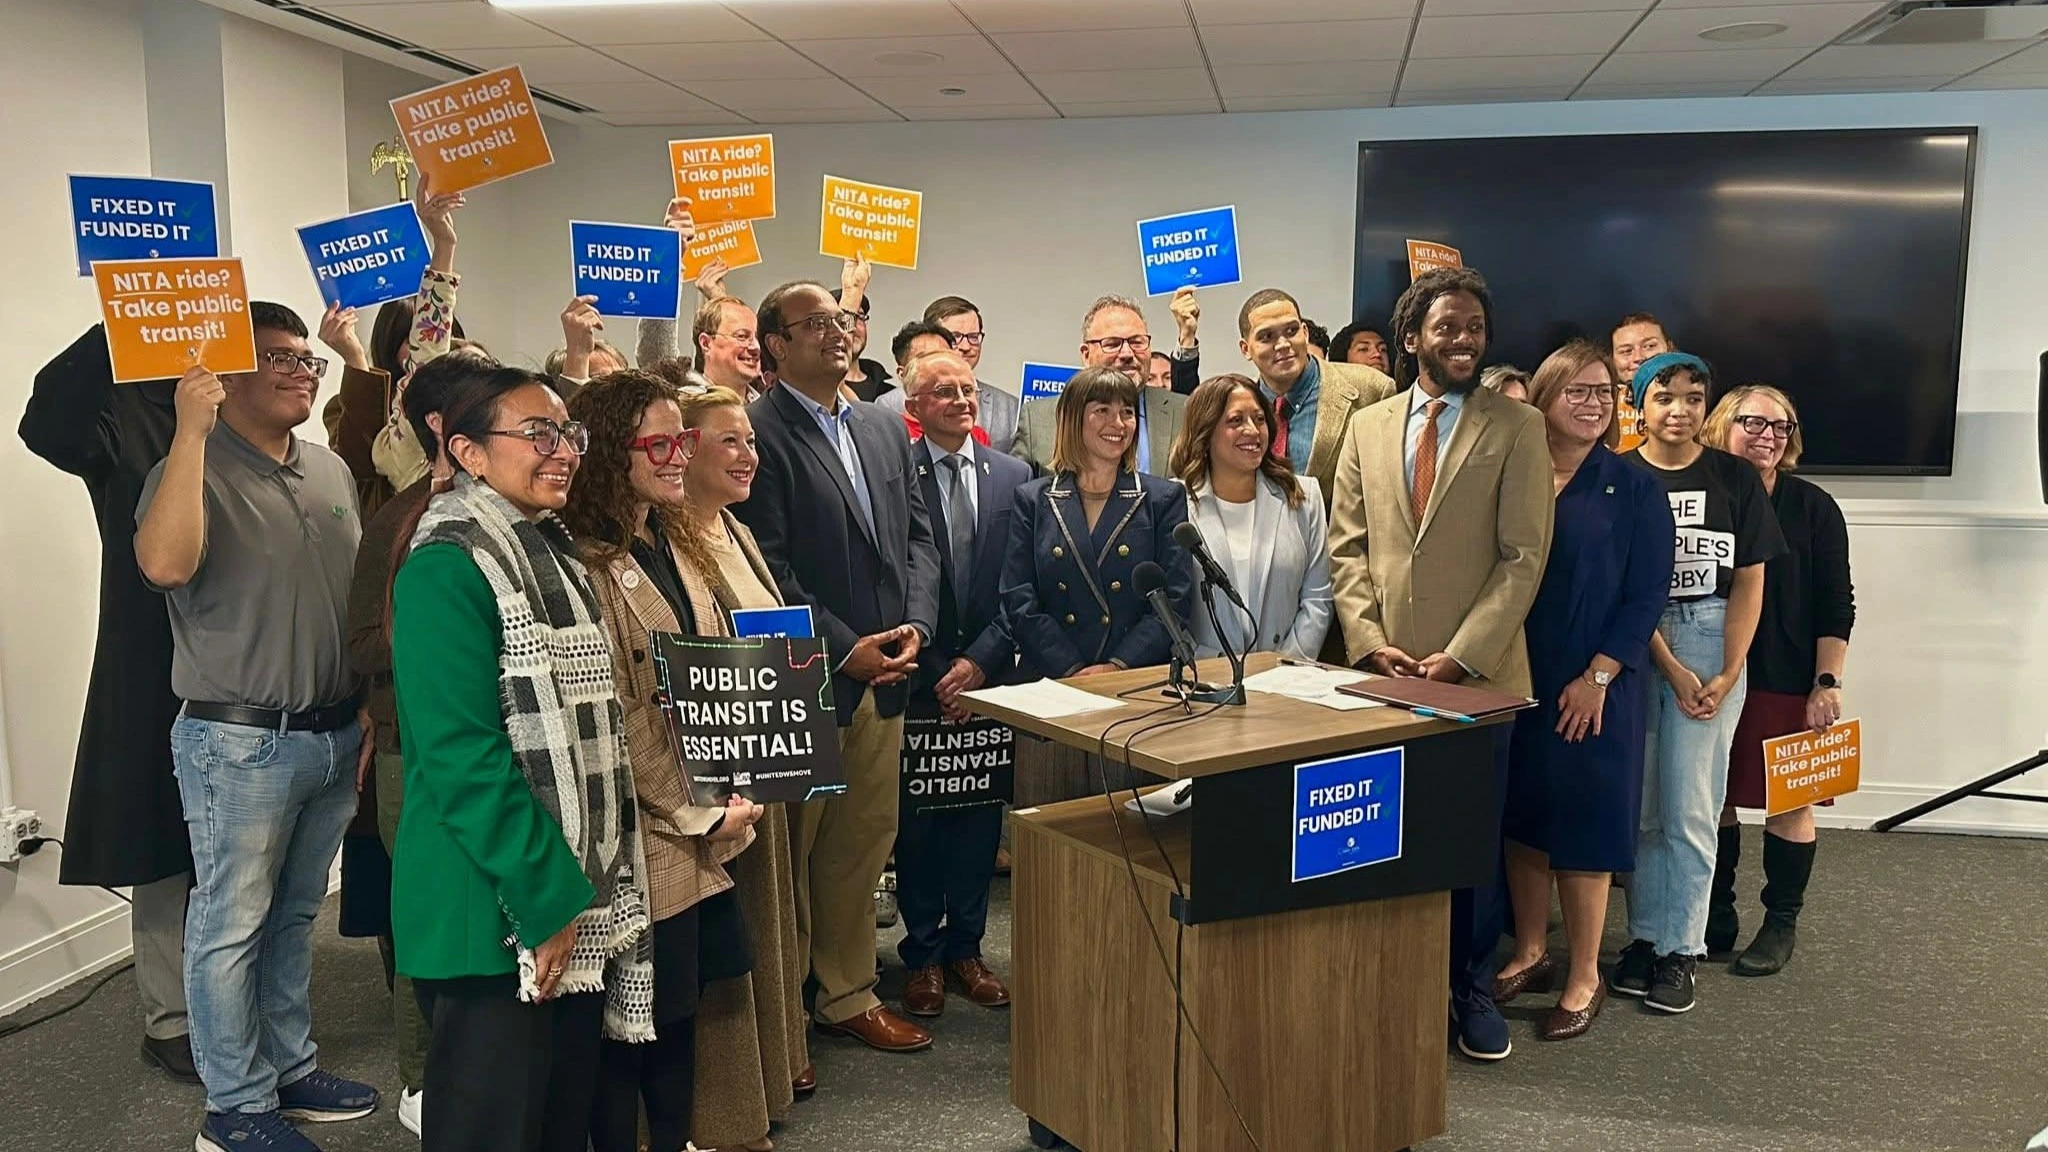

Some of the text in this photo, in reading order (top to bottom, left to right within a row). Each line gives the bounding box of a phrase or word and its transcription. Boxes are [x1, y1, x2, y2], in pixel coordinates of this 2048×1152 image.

[408, 78, 511, 124] NITA ride?
[409, 101, 529, 147] Take public
[439, 127, 516, 163] transit!
[682, 143, 762, 164] NITA ride?
[678, 163, 769, 183] Take public
[698, 182, 755, 200] transit!
[833, 186, 911, 210] NITA ride?
[91, 198, 176, 217] FIXED IT
[828, 202, 915, 229] Take public
[80, 221, 190, 241] FUNDED IT
[707, 220, 748, 241] public
[841, 222, 898, 243] transit!
[1152, 227, 1208, 249] FIXED IT
[320, 229, 388, 258] FIXED IT
[587, 243, 652, 262] FIXED IT
[691, 236, 738, 258] transit!
[1415, 247, 1438, 259] NITA
[317, 246, 405, 281] FUNDED IT
[1145, 244, 1218, 267] FUNDED IT
[113, 269, 230, 292] NITA ride?
[578, 265, 660, 284] FUNDED IT
[108, 296, 244, 320] Take public
[140, 322, 227, 344] transit!
[1032, 379, 1066, 393] FIXED
[1672, 499, 1697, 518] HE
[1675, 536, 1729, 559] PLE'S
[1670, 568, 1709, 589] BBY
[689, 666, 778, 692] PUBLIC
[676, 699, 807, 726] TRANSIT IS
[682, 731, 813, 761] ESSENTIAL!
[901, 727, 1013, 750] ESSENTIA
[1775, 728, 1851, 759] NITA ride?
[915, 749, 1011, 773] TRANSIT
[1770, 745, 1857, 777] Take public
[908, 773, 990, 795] PUBLIC
[1786, 764, 1841, 790] transit!
[1309, 779, 1373, 807] FIXED IT
[1299, 803, 1381, 835] FUNDED IT
